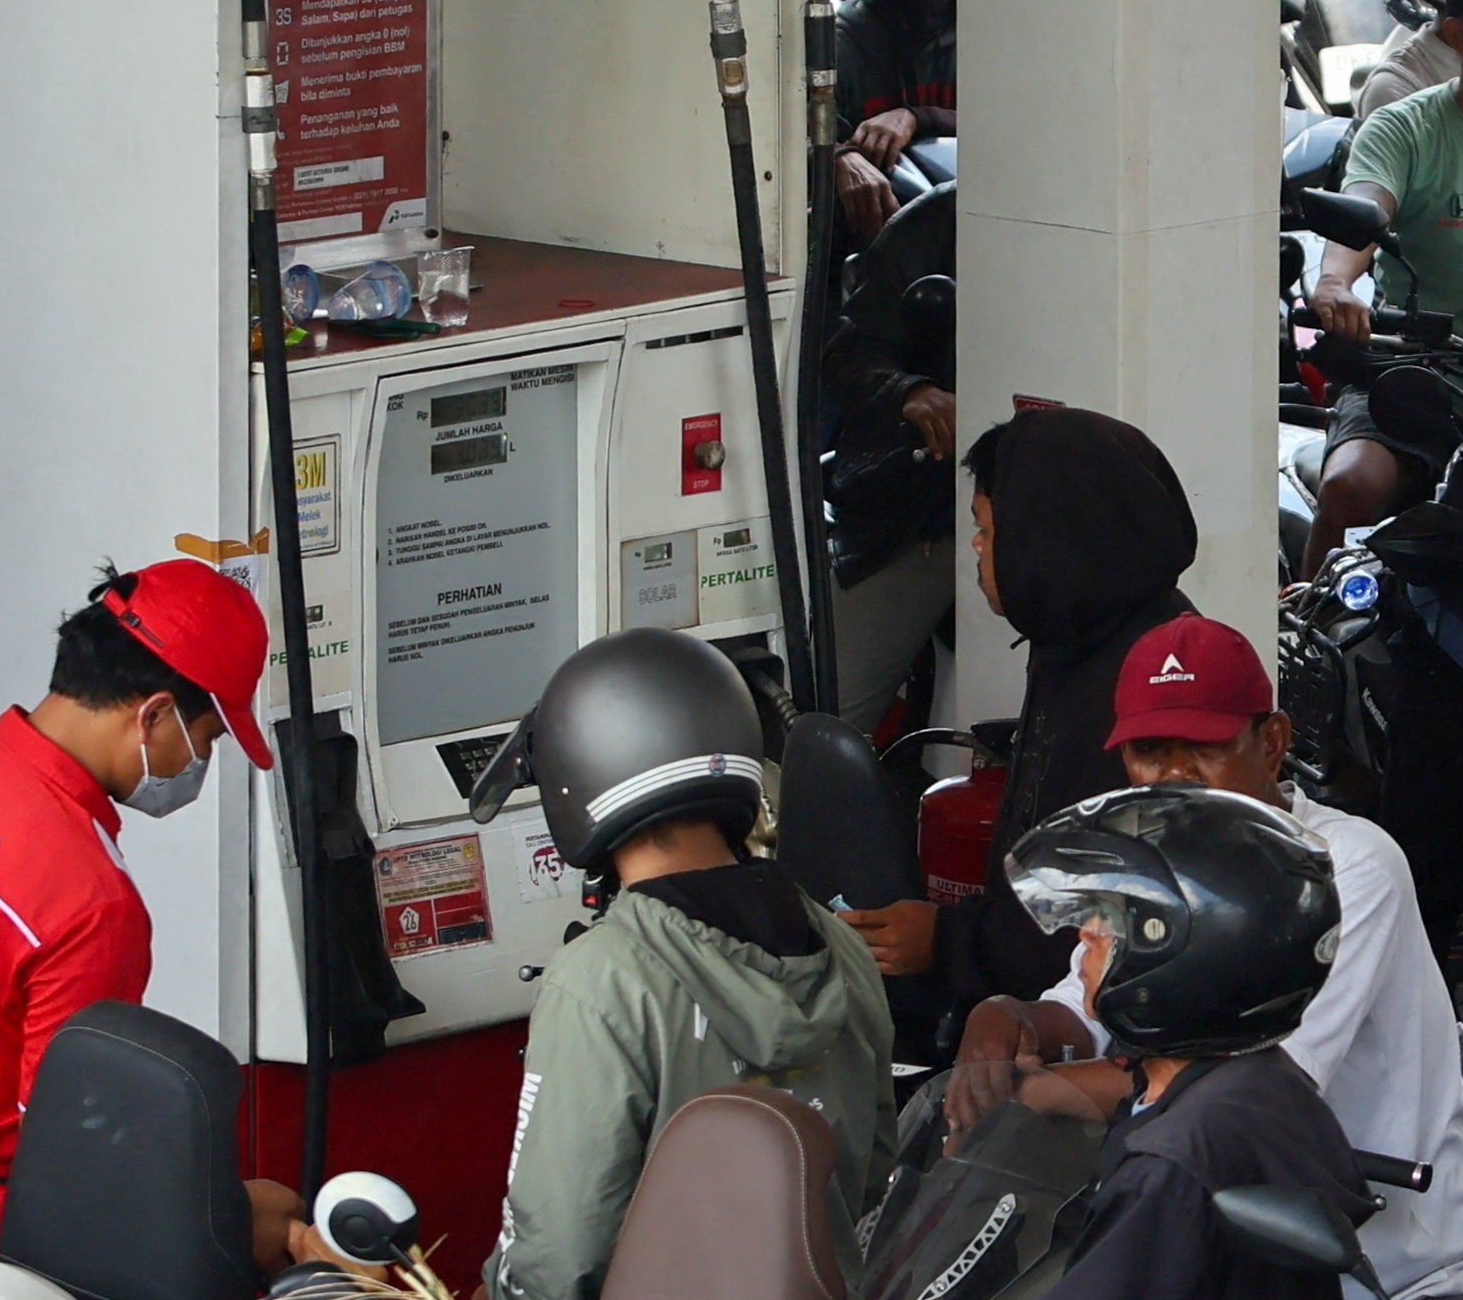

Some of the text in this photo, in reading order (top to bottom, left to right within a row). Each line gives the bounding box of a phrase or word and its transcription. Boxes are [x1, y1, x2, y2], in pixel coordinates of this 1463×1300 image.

[275, 7, 292, 26] 3S
[333, 9, 358, 23] Sapa)
[360, 7, 377, 19] dari
[378, 4, 414, 18] petugas
[355, 31, 382, 44] angka
[390, 26, 411, 38] (nol)
[301, 51, 338, 63] sebelum
[384, 41, 405, 53] BBM
[301, 63, 423, 87] Menerima bukti pembayaran
[301, 87, 351, 102] bila diminta
[301, 103, 400, 125] Penanganan yang baik
[301, 118, 401, 140] terhadap keluhan Anda
[510, 363, 574, 381] MATIKAN MESIN
[510, 373, 575, 392] WAKTU MENGISI
[416, 411, 428, 421] Rp
[436, 422, 504, 442] JUMLAH HARGA
[510, 442, 516, 452] L
[295, 451, 326, 490] 3M
[443, 468, 493, 483] DIKELUARKAN
[693, 479, 709, 489] STOP
[296, 491, 332, 507] syarakat
[713, 537, 722, 546] Rp
[700, 564, 775, 588] PERTALITE
[437, 582, 503, 606] PERHATIAN
[270, 640, 349, 666] PEALITE
[402, 909, 418, 932] 26
